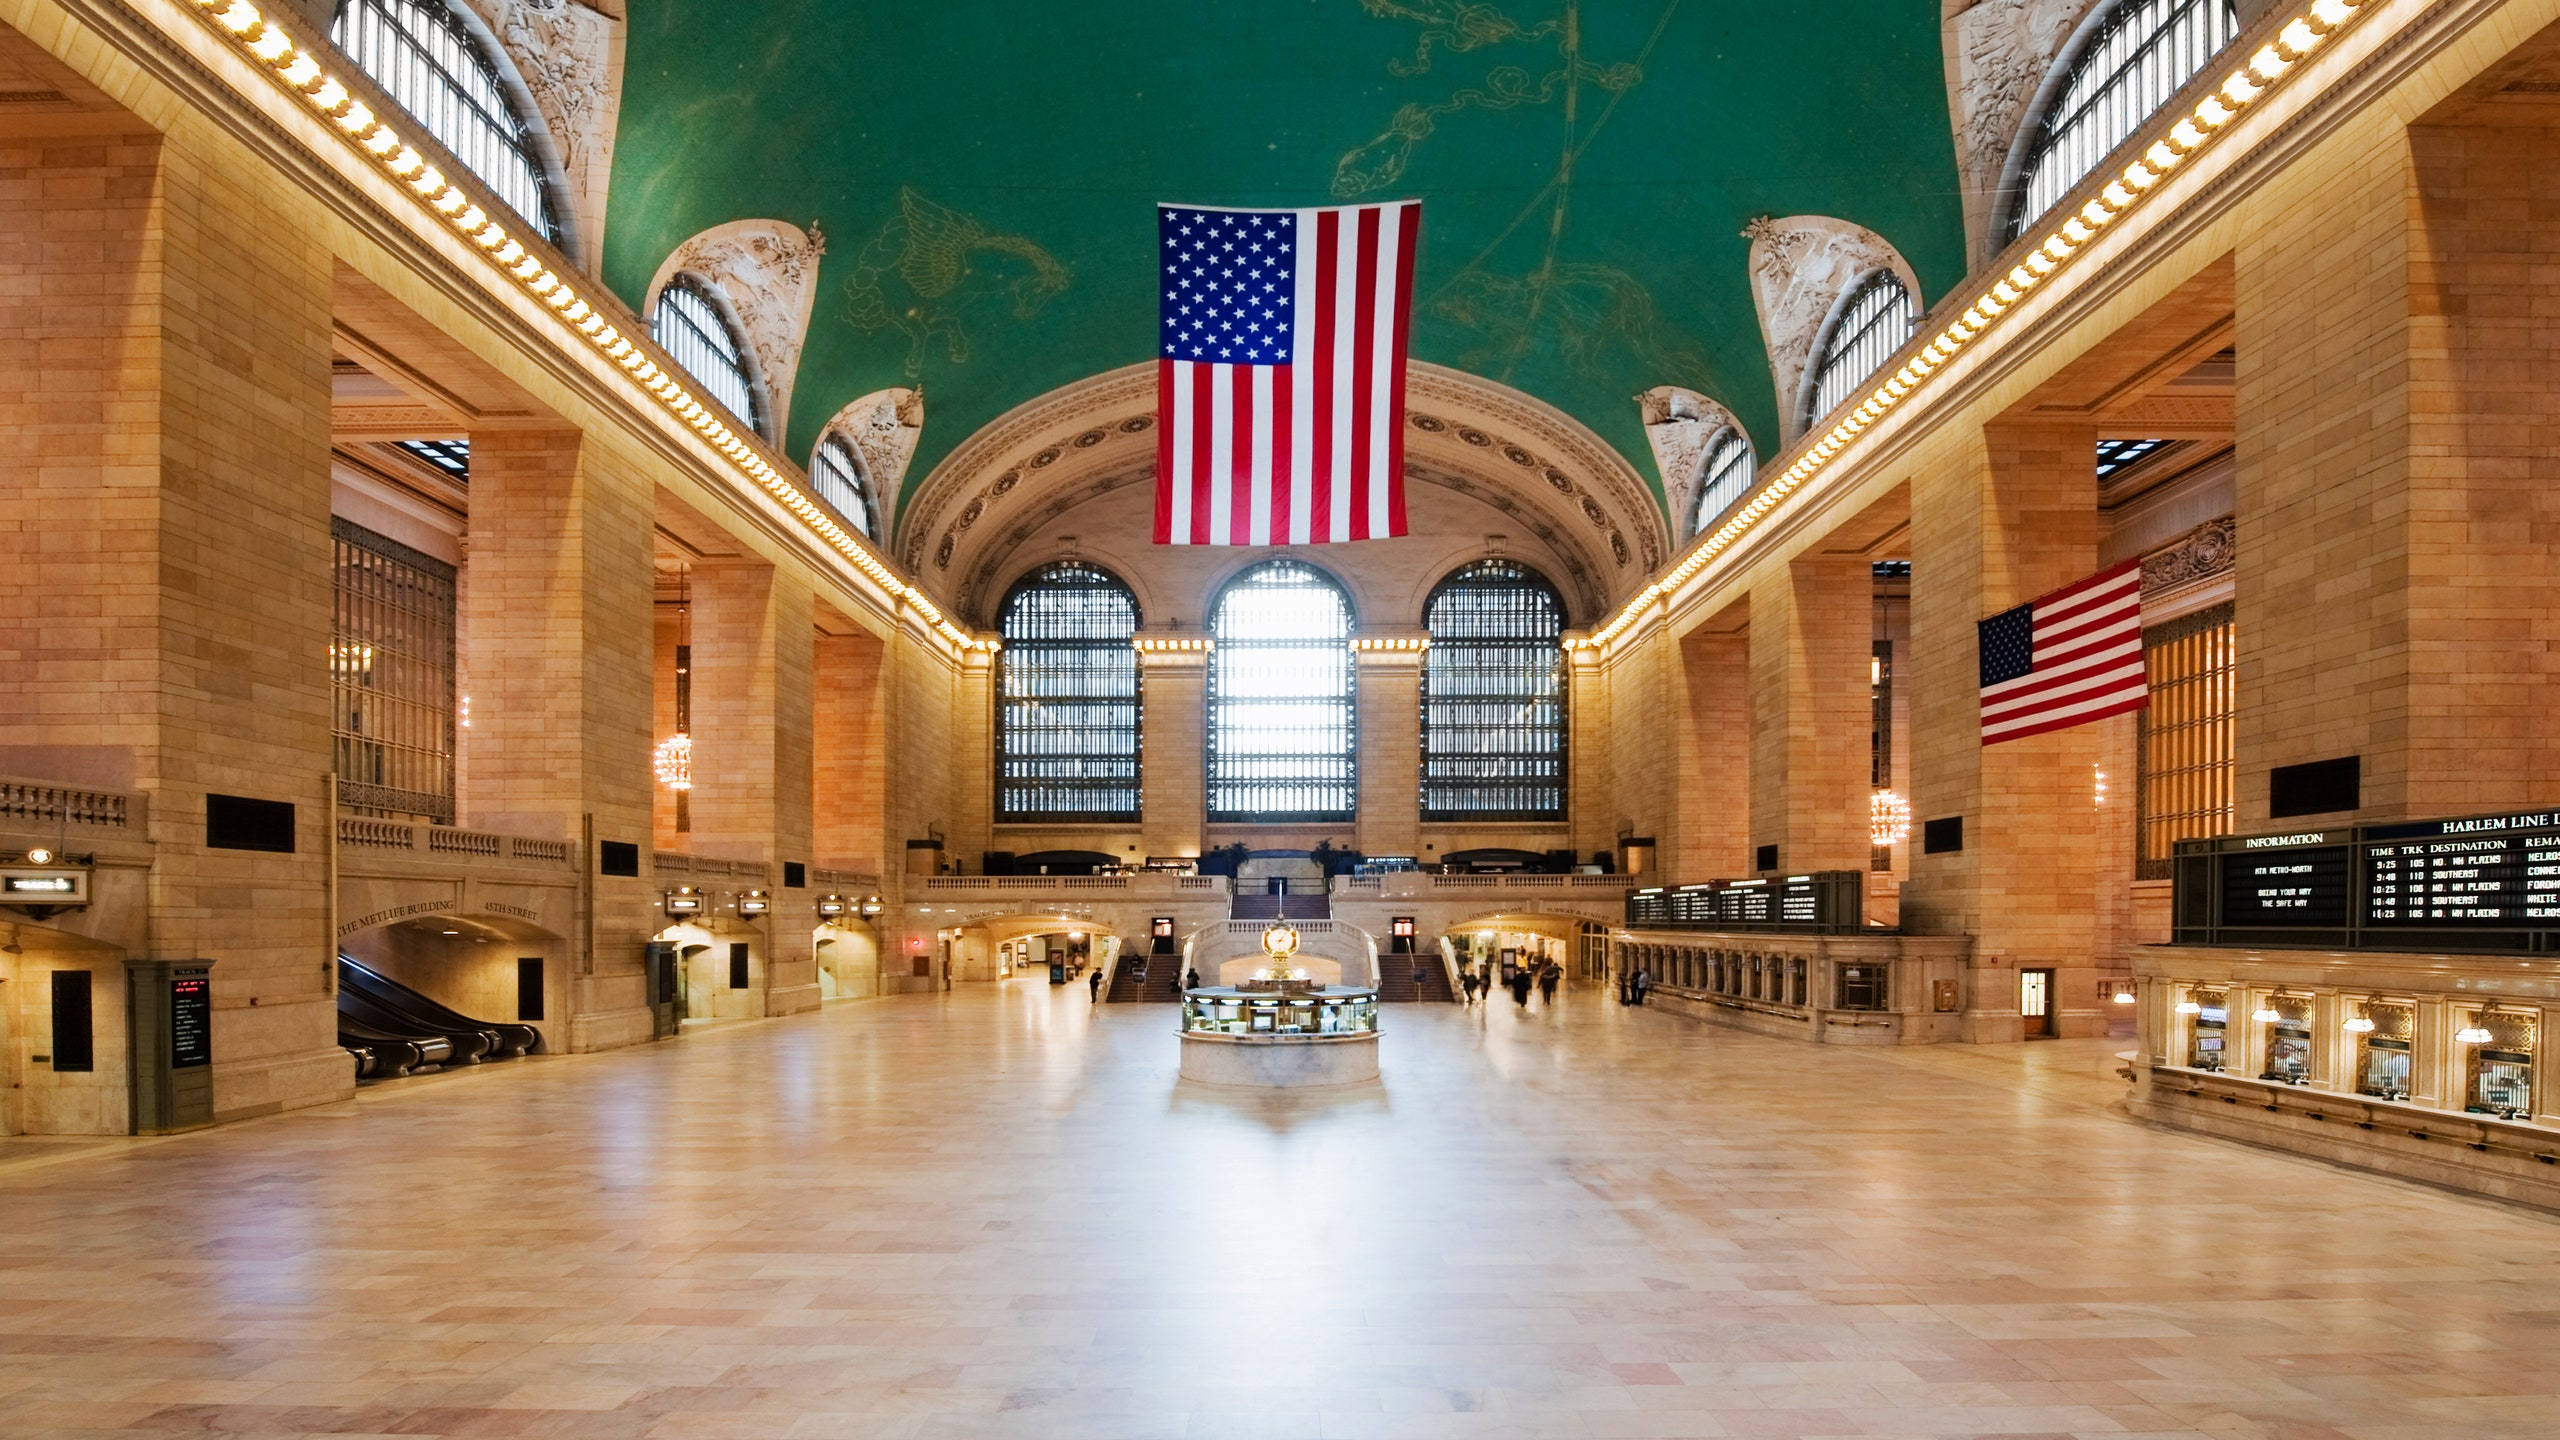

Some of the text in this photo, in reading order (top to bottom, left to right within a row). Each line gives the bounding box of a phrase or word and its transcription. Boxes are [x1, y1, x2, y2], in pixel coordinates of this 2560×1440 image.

[2443, 818, 2506, 833] HARLEM
[2511, 814, 2549, 828] LINE
[2246, 833, 2324, 848] INFORMATION
[2370, 847, 2394, 856] TIME
[2401, 846, 2424, 855] TRK
[2430, 840, 2507, 854] DESTINATION
[2377, 861, 2396, 869] 9:25
[2468, 855, 2501, 864] PLAINS
[2410, 872, 2424, 880] 110
[2433, 869, 2479, 879] SOUTHEAST
[2468, 882, 2501, 891] PLAINS
[2409, 896, 2424, 905] 110
[2432, 895, 2479, 904] SOUTHEAST
[2527, 894, 2558, 903] WHITE
[337, 900, 454, 937] THE METLIFE BUILDING
[484, 902, 537, 921] 45TH STREET
[2467, 908, 2500, 917] PLAINS
